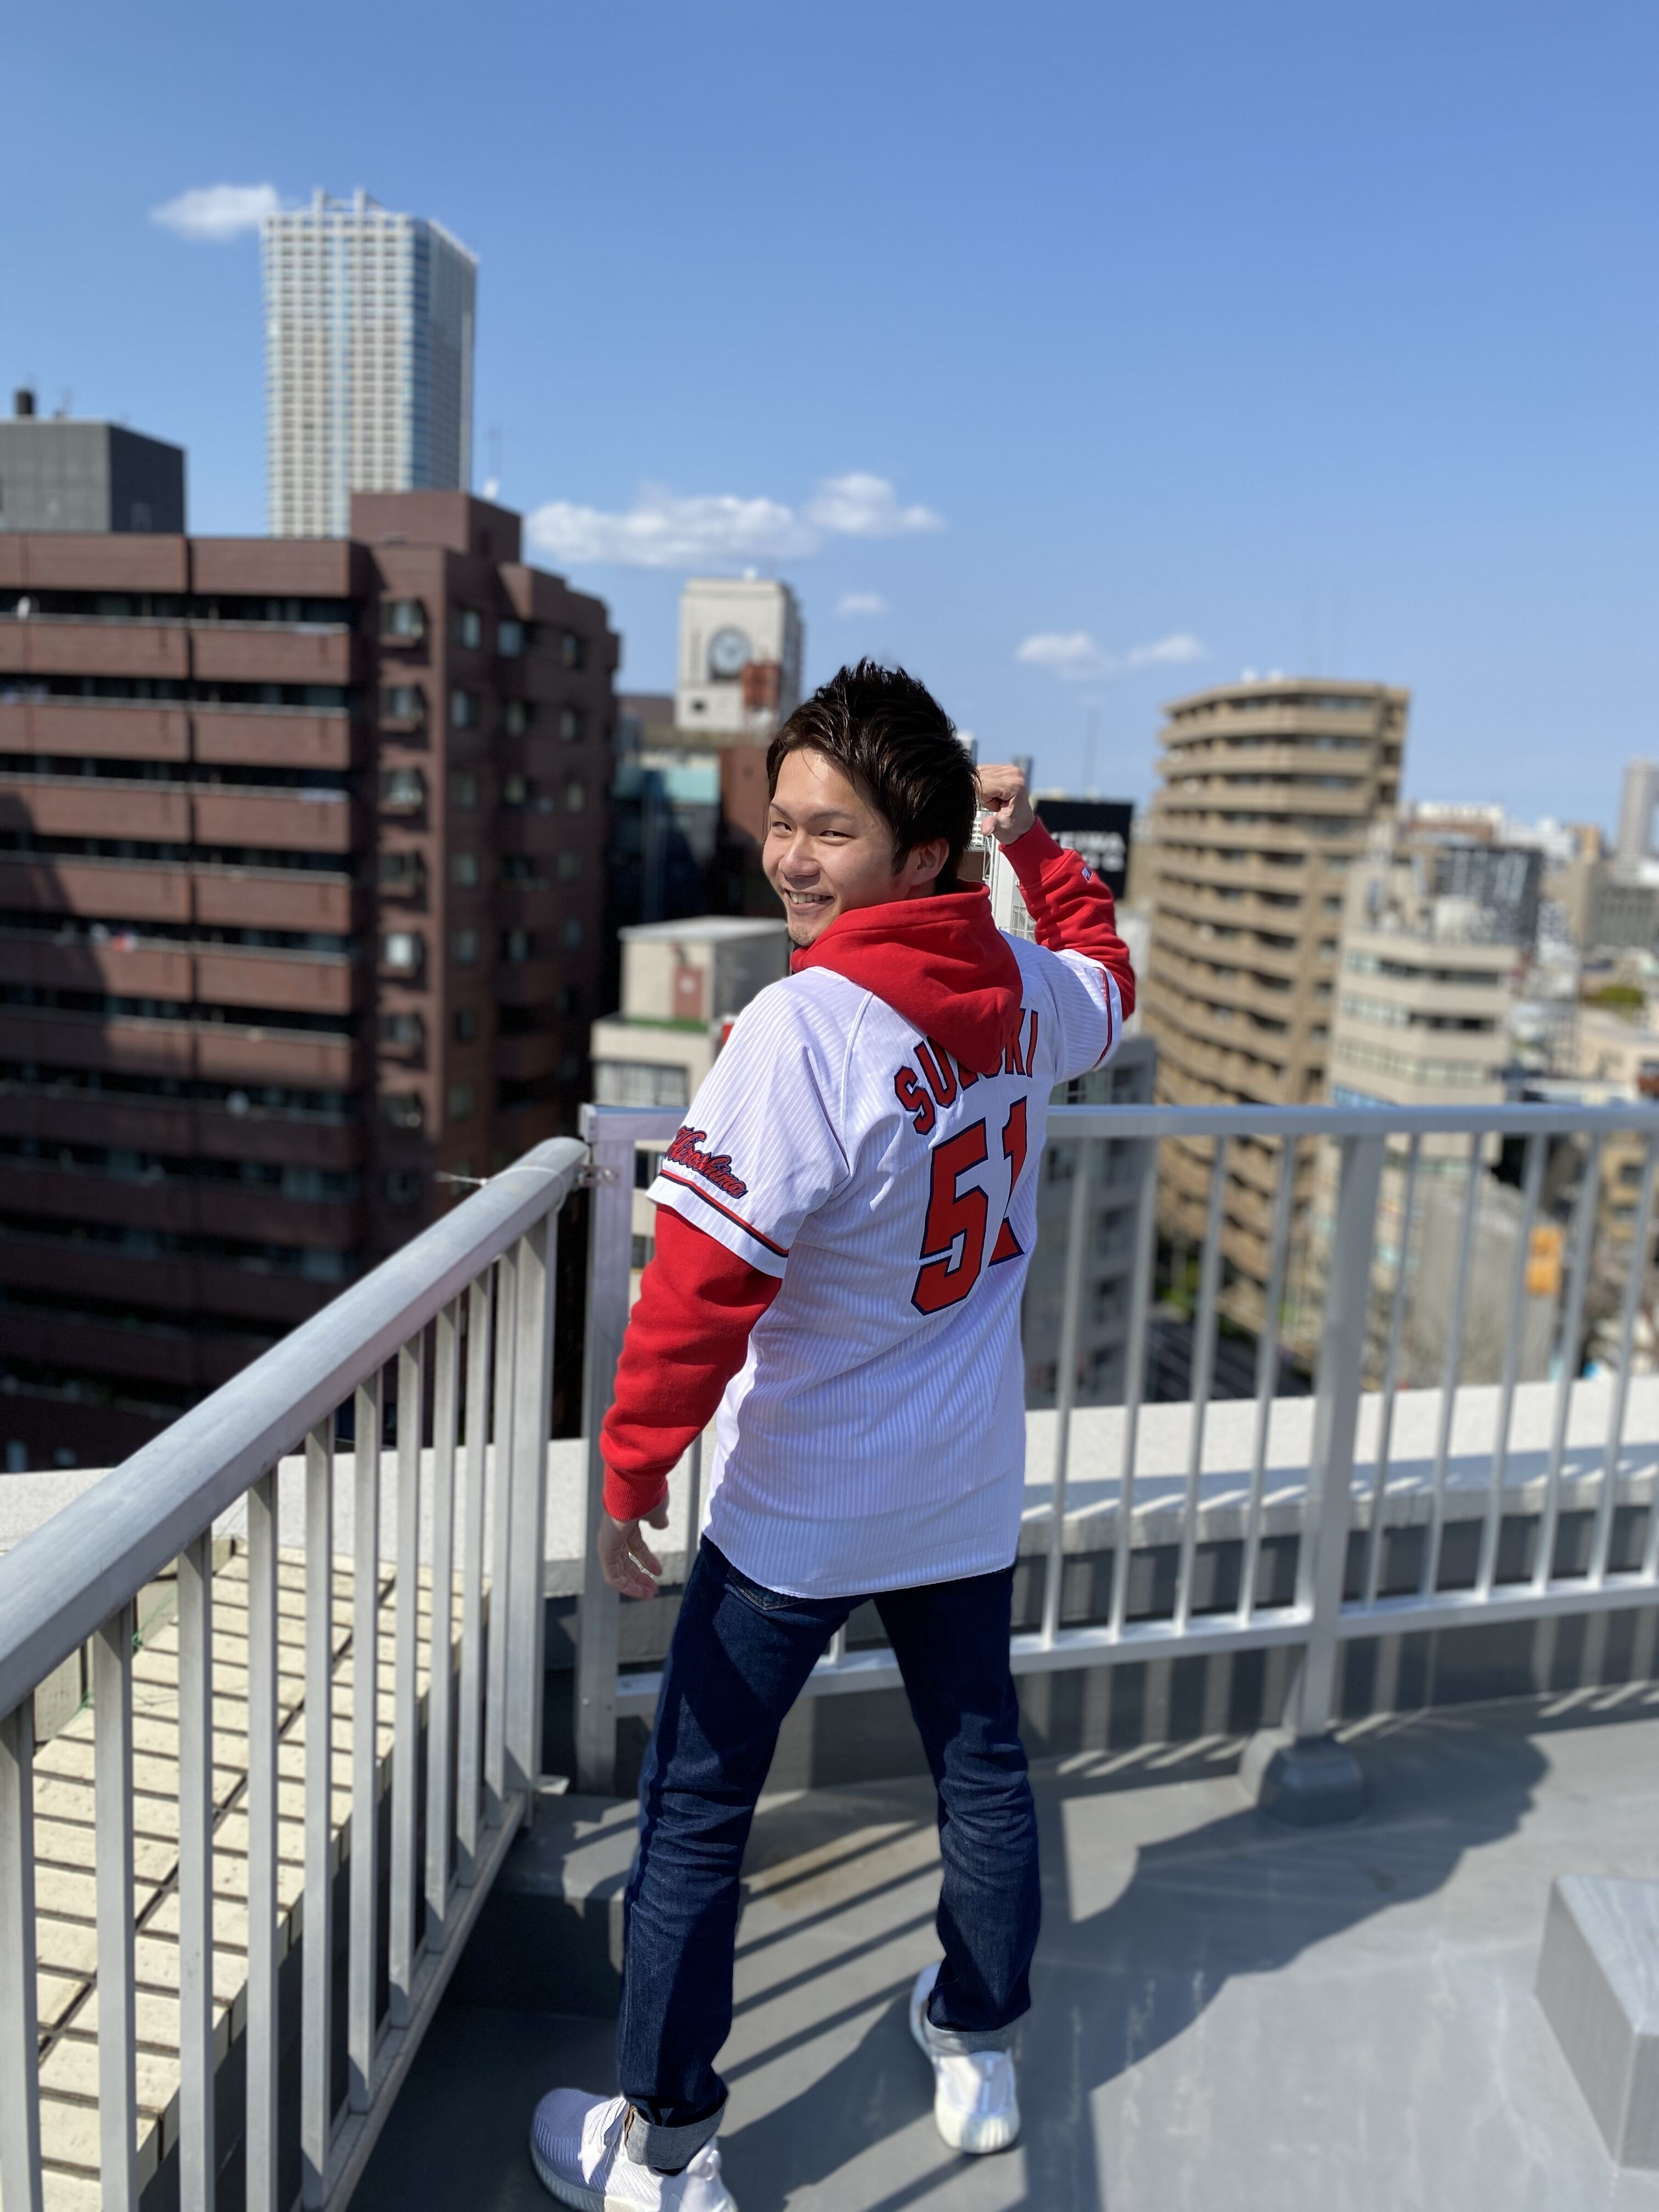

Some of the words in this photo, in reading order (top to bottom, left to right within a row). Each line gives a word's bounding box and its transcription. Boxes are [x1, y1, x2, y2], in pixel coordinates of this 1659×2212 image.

[894, 1008, 1038, 1135] SUKI
[666, 1125, 749, 1199] Hiroshima
[911, 1095, 1027, 1316] 51
